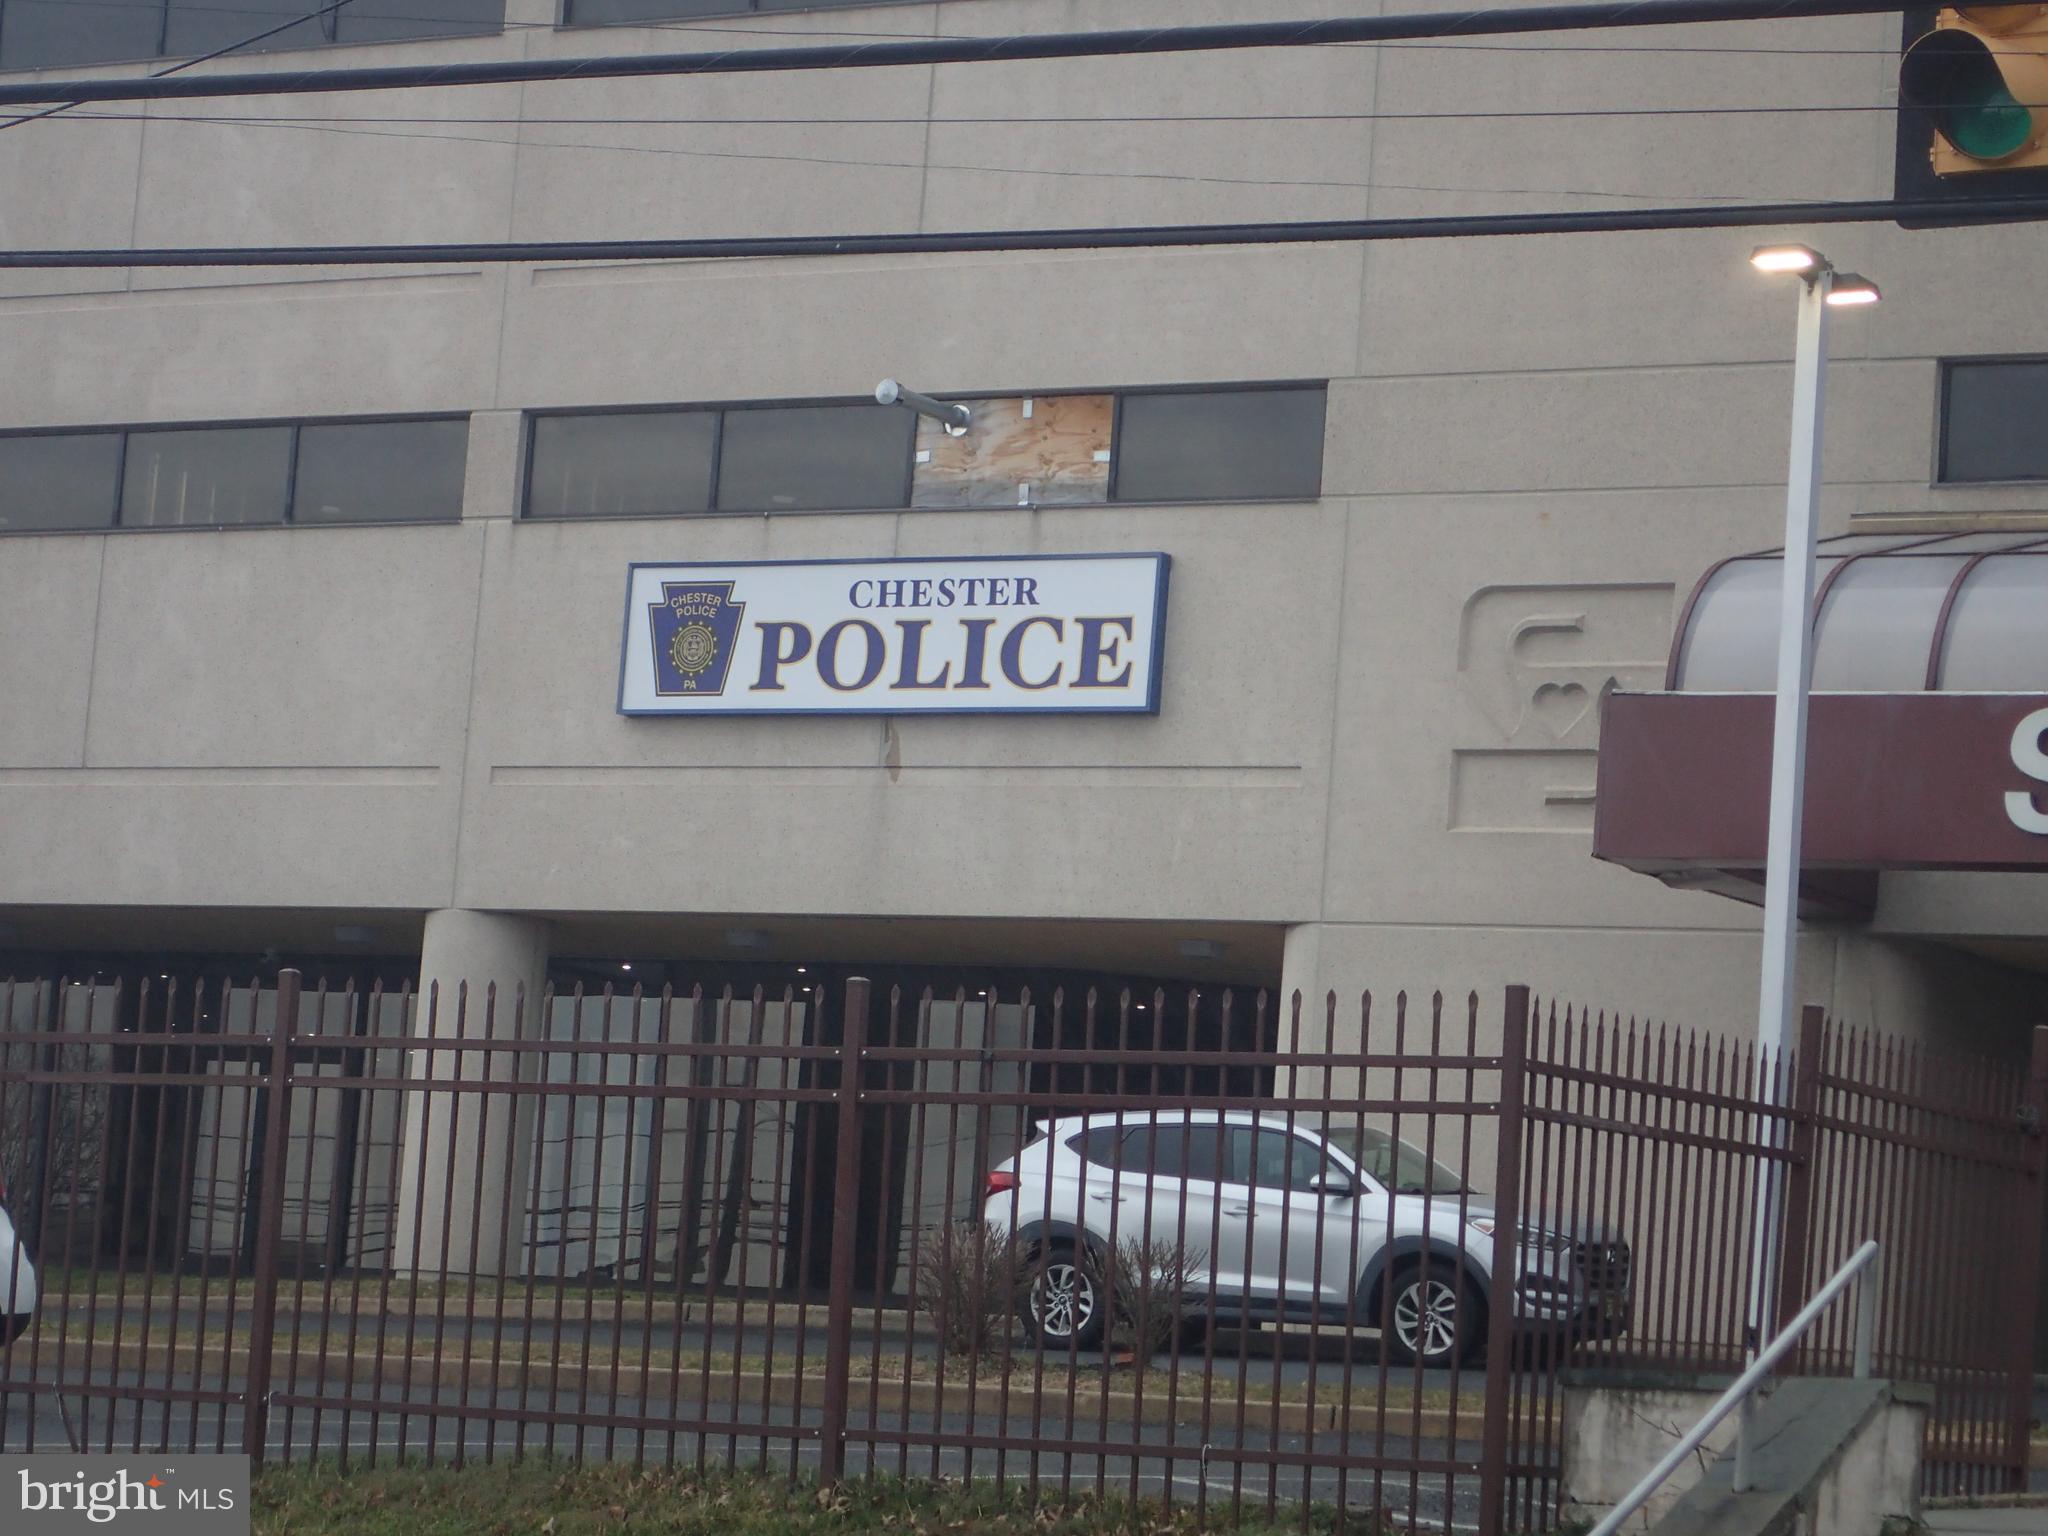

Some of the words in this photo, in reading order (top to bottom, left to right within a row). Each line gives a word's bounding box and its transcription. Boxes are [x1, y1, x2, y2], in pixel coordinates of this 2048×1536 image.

[671, 593, 721, 607] CHESTER
[848, 577, 1040, 609] CHESTER
[676, 606, 717, 618] POLICE
[748, 615, 1136, 692] POLICE
[683, 679, 697, 689] PA
